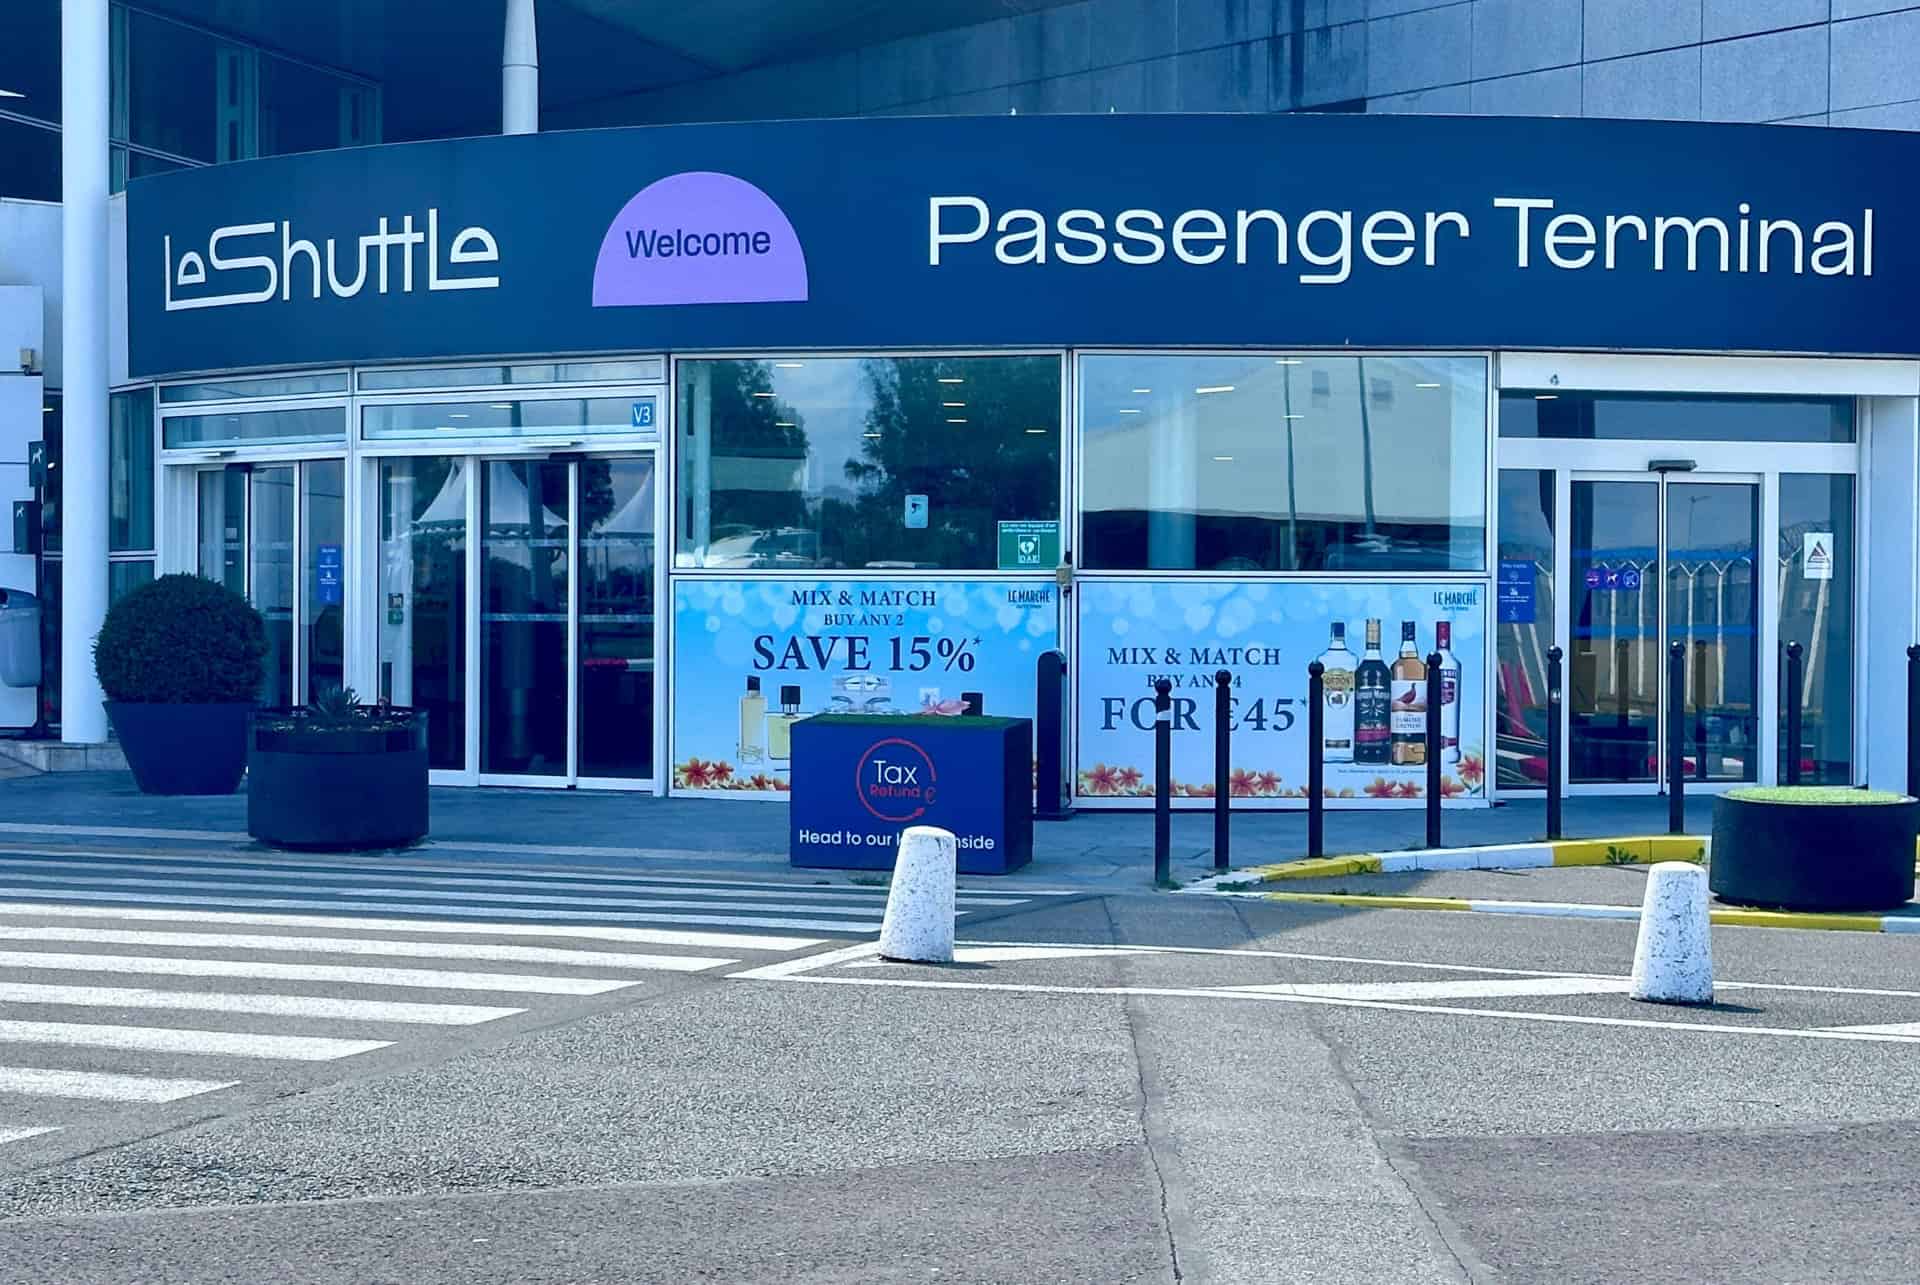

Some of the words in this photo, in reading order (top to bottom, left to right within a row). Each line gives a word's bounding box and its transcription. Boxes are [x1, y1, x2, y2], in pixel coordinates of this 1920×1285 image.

[625, 228, 772, 259] Welcome
[929, 195, 1471, 284] Passenger
[1493, 197, 1873, 276] Terminal
[633, 406, 650, 425] V3
[791, 590, 832, 606] MIX
[838, 590, 853, 606] &
[859, 590, 937, 607] MATCH
[823, 614, 855, 626] BUY
[859, 614, 892, 626] ANY
[895, 614, 904, 626] 2
[753, 635, 871, 671] SAVE
[1106, 647, 1157, 665] MIX
[1164, 647, 1181, 665] &
[1189, 647, 1281, 666] MATCH
[1189, 674, 1217, 688] AN
[1233, 674, 1242, 688] 4
[873, 759, 918, 785] Tax
[869, 784, 921, 797] Refund
[799, 829, 842, 845] Head
[846, 830, 862, 846] to
[866, 834, 892, 847] our
